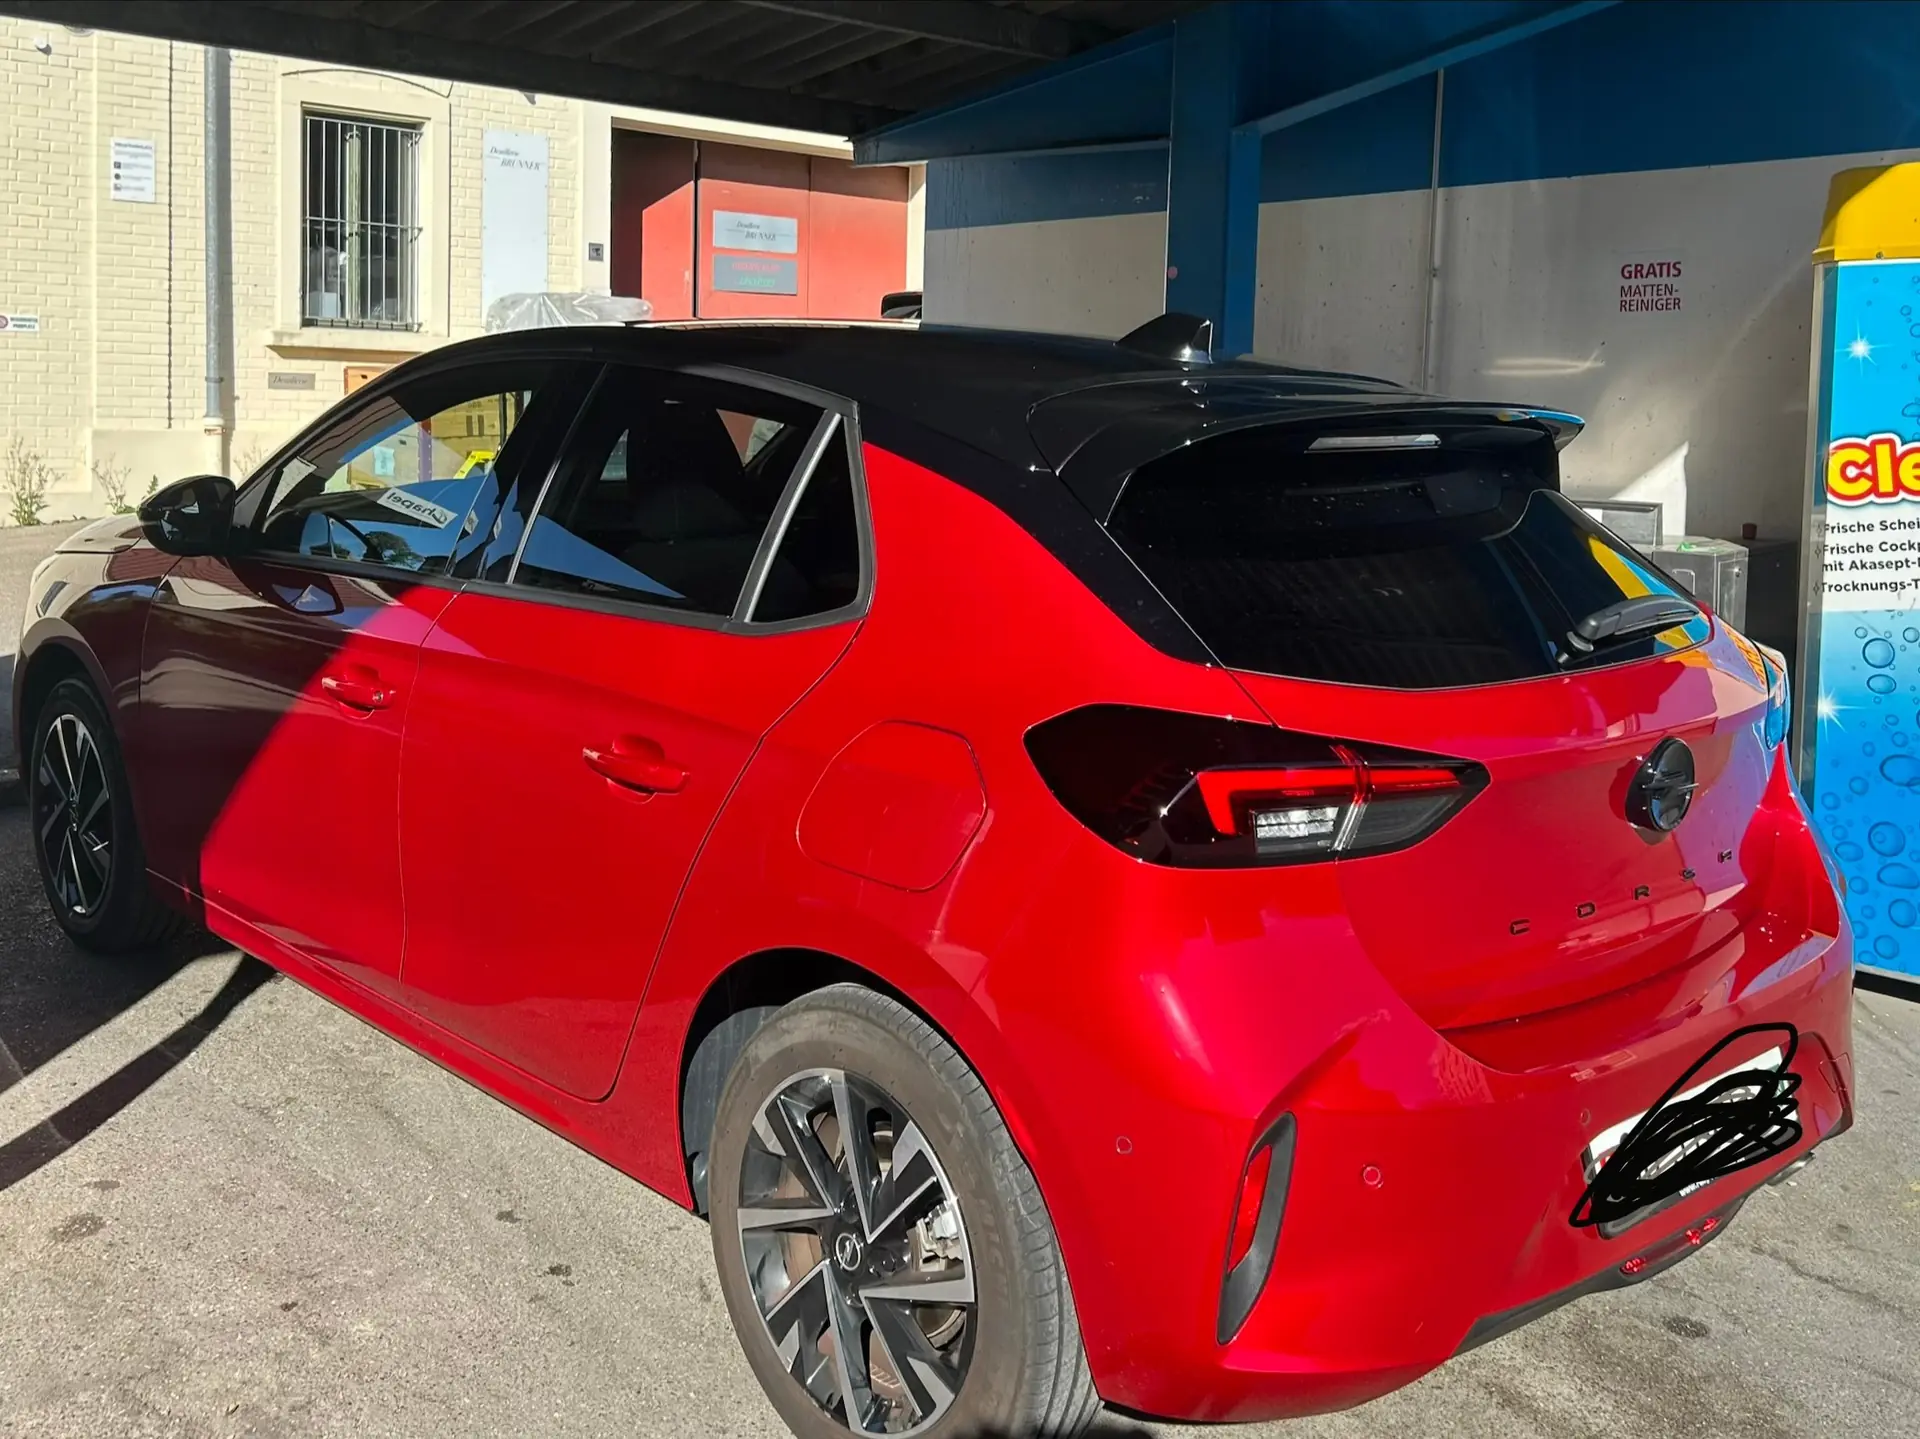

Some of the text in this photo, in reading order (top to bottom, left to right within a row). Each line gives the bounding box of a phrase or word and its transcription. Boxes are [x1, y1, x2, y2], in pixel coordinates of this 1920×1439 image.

[1620, 261, 1682, 280] GRATIS
[1620, 283, 1679, 298] MATTEN-
[1619, 297, 1682, 312] REINIGER
[1879, 517, 1920, 531] Schei
[1822, 542, 1874, 555] Frische
[1821, 560, 1844, 572] mit
[1821, 578, 1920, 593] Trocknungs-T
